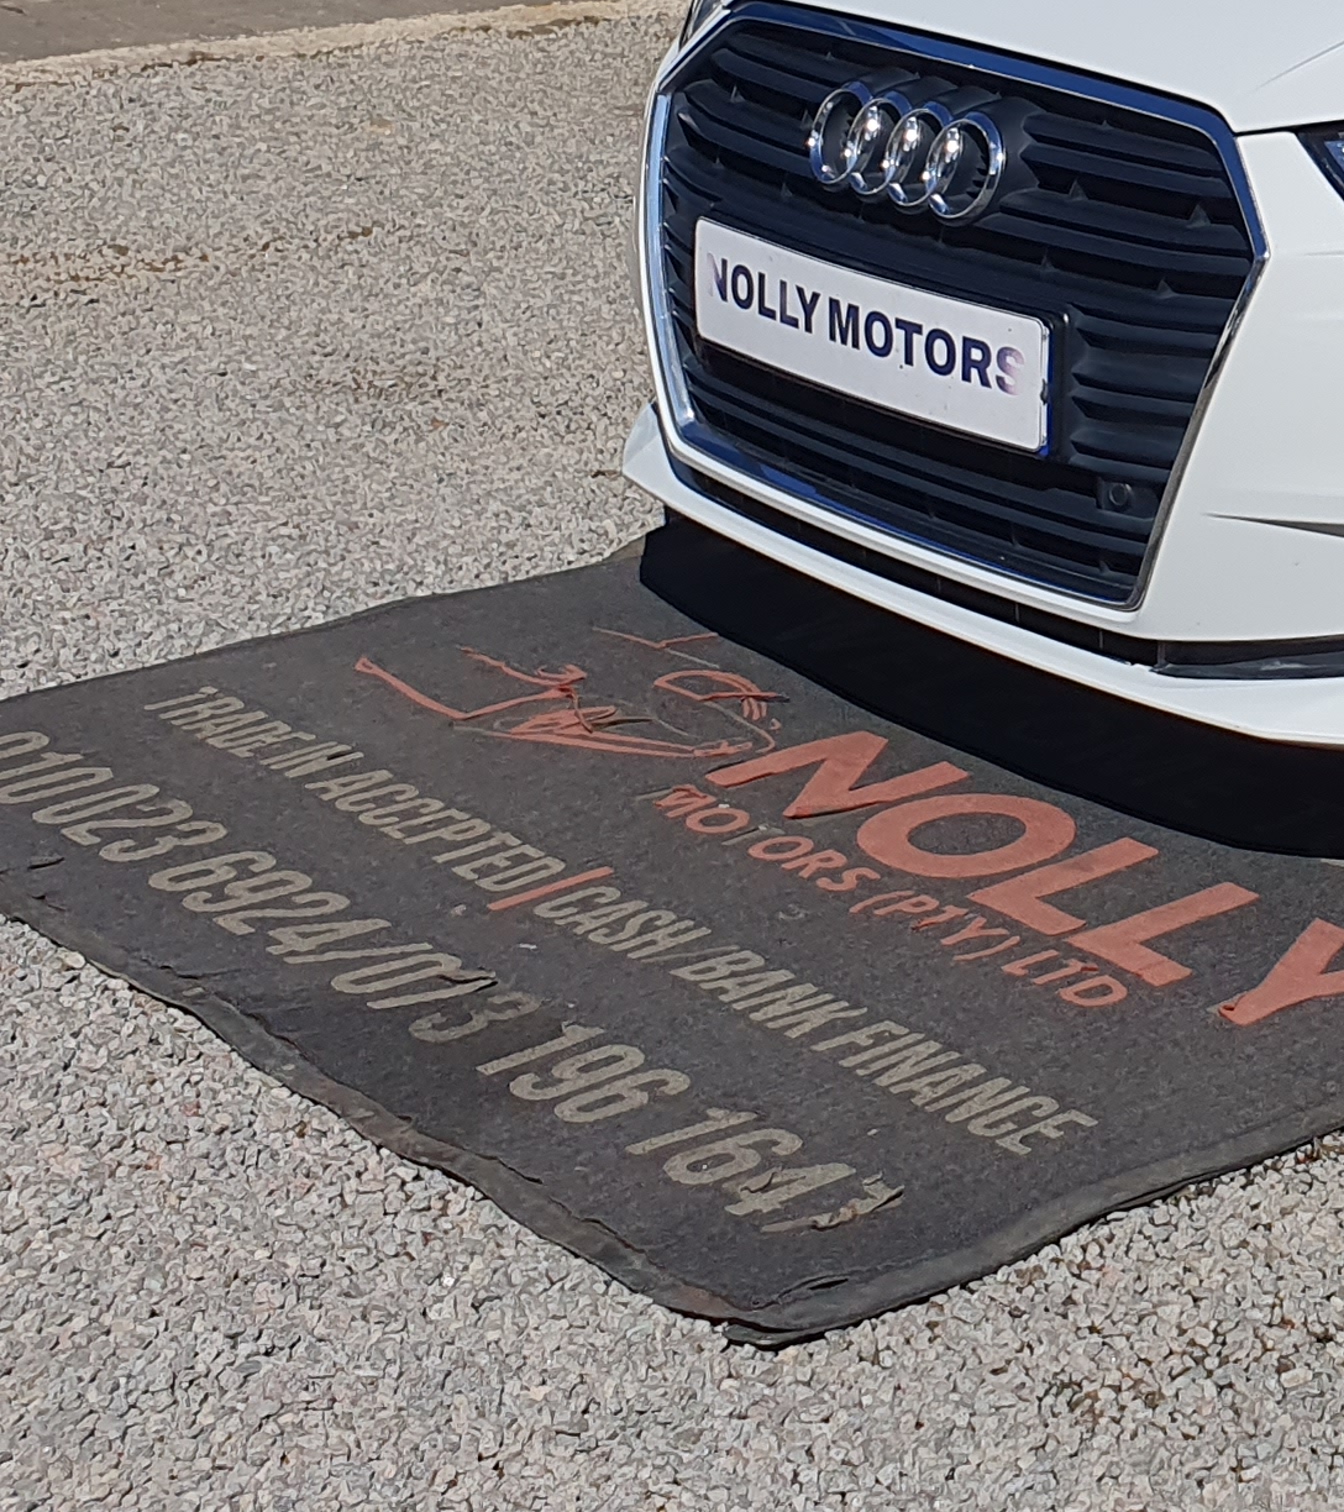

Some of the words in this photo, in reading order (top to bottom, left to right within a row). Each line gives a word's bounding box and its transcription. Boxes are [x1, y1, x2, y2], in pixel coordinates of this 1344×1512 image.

[706, 252, 821, 335] NOLLY
[828, 296, 1025, 396] MOTORS
[144, 686, 316, 758] TRADE
[260, 742, 364, 778] IN
[810, 1020, 1098, 1155] FINANCE
[849, 890, 1021, 962] (PTY)
[1001, 949, 1128, 1007] LTD
[476, 1020, 691, 1124] 196
